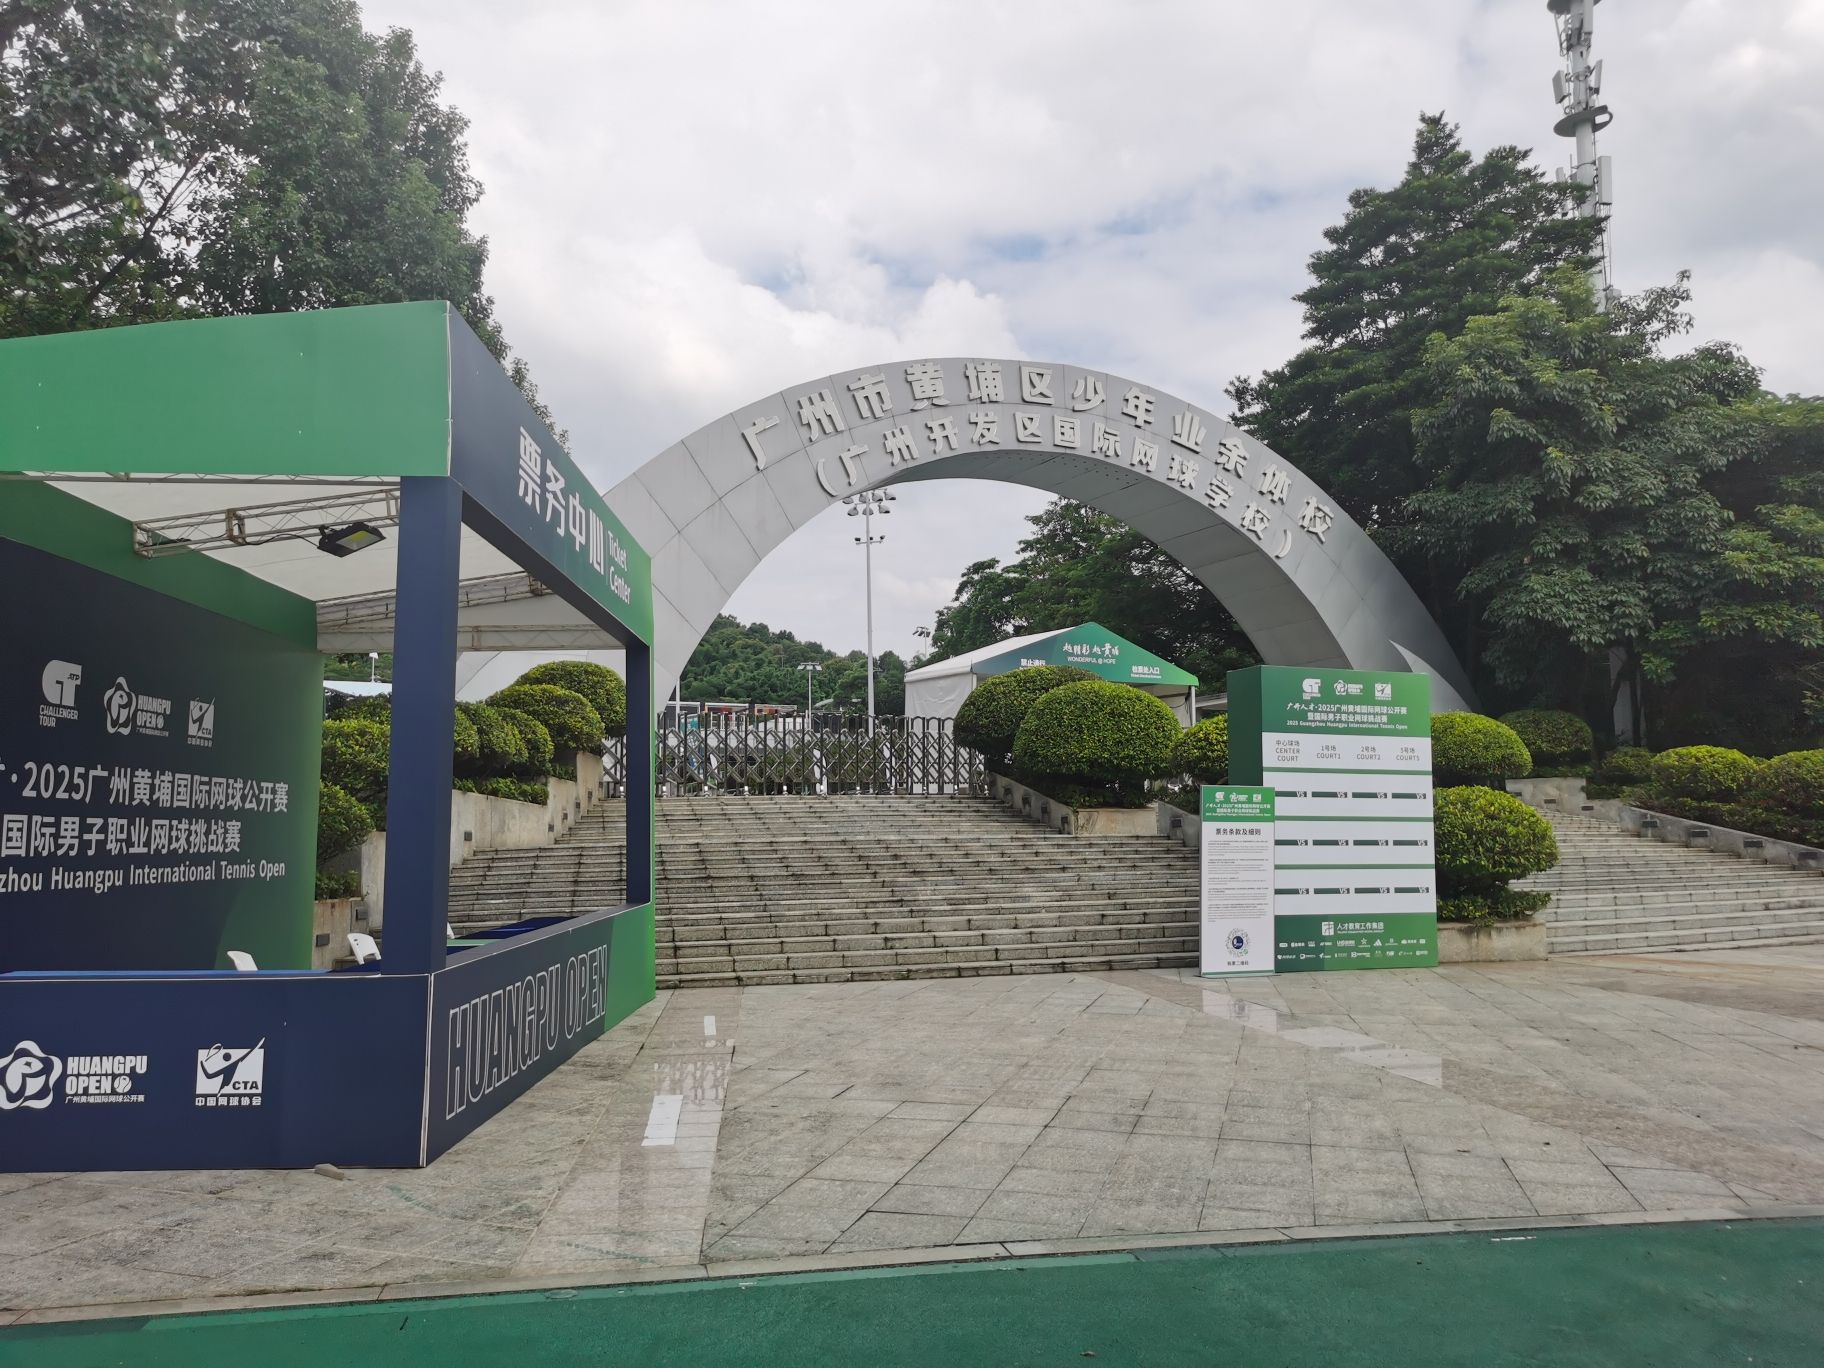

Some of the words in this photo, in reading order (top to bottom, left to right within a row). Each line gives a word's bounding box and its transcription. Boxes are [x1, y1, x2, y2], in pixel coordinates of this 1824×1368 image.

[741, 361, 1332, 545] 广州市黄埔区少年业余体校
[816, 410, 1292, 559] （广州开发区国际网球学校）
[518, 426, 604, 575] 票务中心
[607, 530, 628, 572] Ticket
[609, 566, 631, 605] Center
[39, 704, 79, 720] CHALLENGER
[138, 694, 171, 715] HUANGPU
[39, 715, 56, 728] TOUR
[136, 712, 158, 728] OPEN
[201, 727, 212, 737] CTA
[0, 760, 289, 813] ·2025广州黄埔国际网球公开赛
[1215, 828, 1262, 836] 票务条款及细则
[51, 867, 123, 894] Huangpu
[130, 860, 216, 886] International
[220, 858, 256, 880] Tennis
[259, 859, 286, 881] Open
[446, 963, 561, 1121] HUANGPU
[564, 944, 608, 1039] OPEN
[66, 1055, 148, 1075] HUANGPU
[65, 1076, 112, 1095] OPEN
[231, 1080, 260, 1091] CTA
[65, 1094, 145, 1104] 广州黄埔国际网球公开赛
[195, 1096, 262, 1106] 中国网球协会
